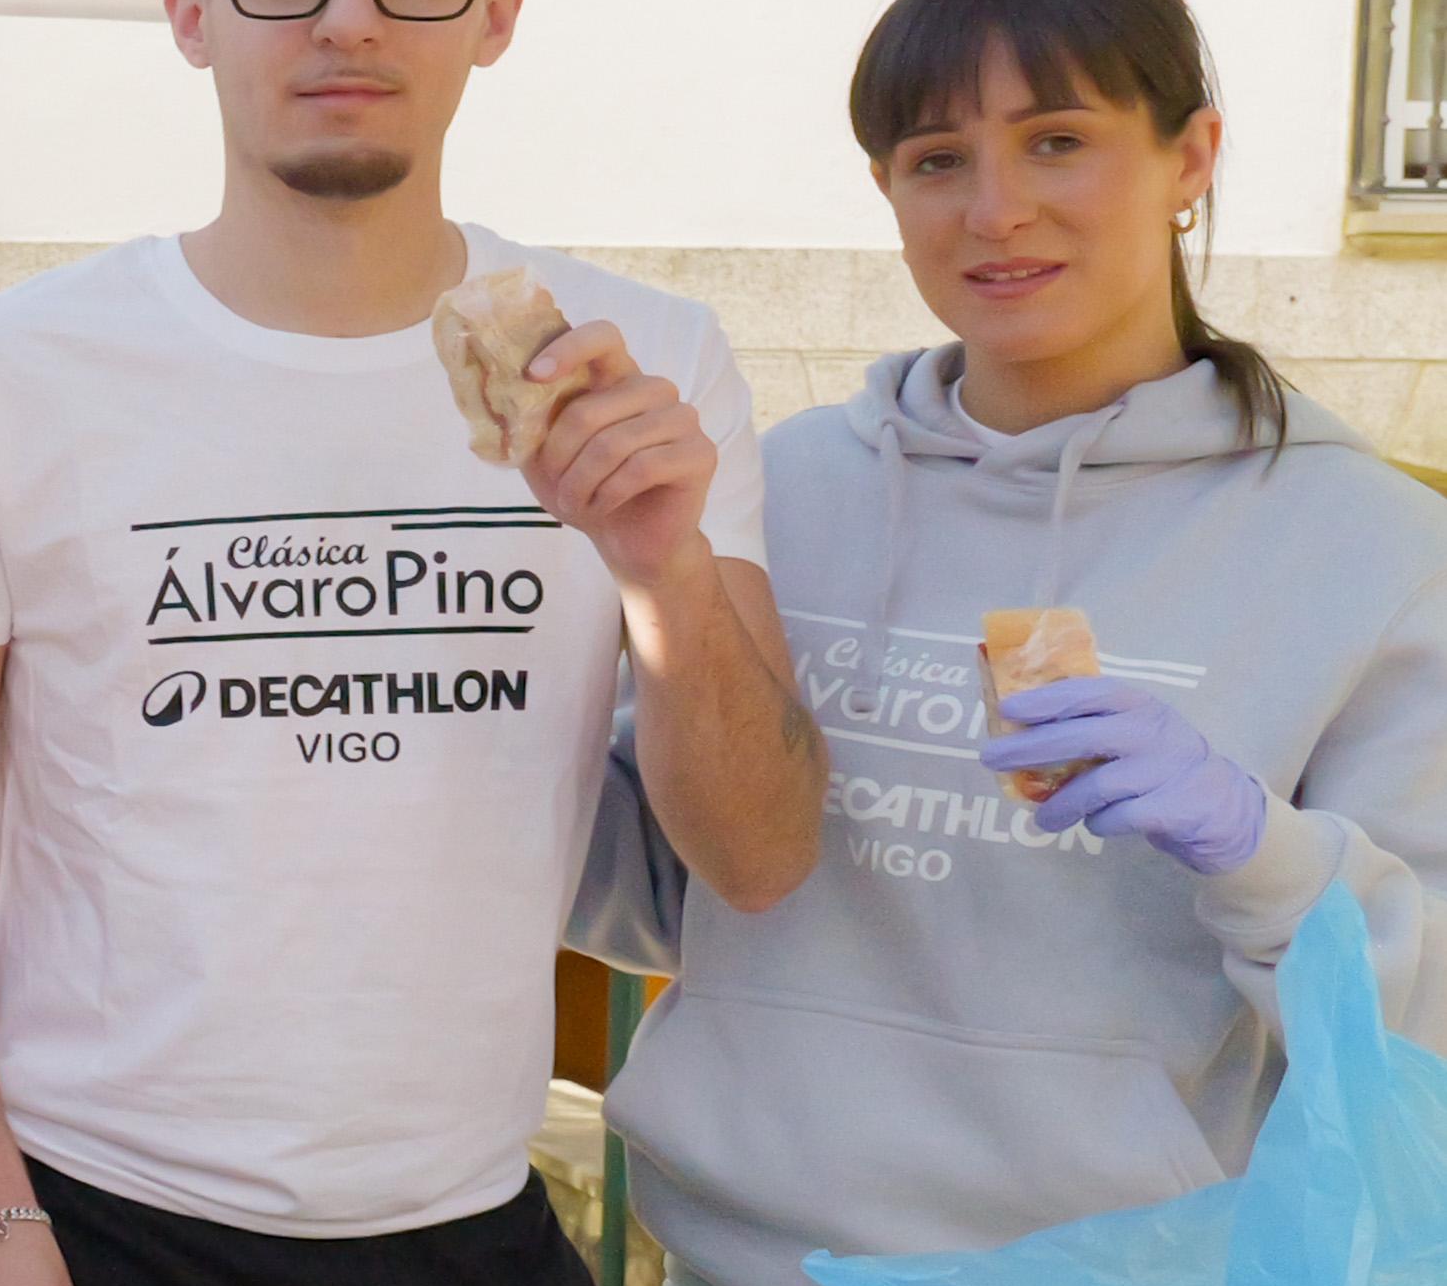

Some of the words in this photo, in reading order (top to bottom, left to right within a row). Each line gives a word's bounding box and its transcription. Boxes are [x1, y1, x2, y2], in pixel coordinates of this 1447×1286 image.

[227, 535, 369, 570] Clásica
[219, 669, 529, 719] DECATHLON
[296, 731, 402, 765] VIGO
[848, 832, 952, 882] VIGO
